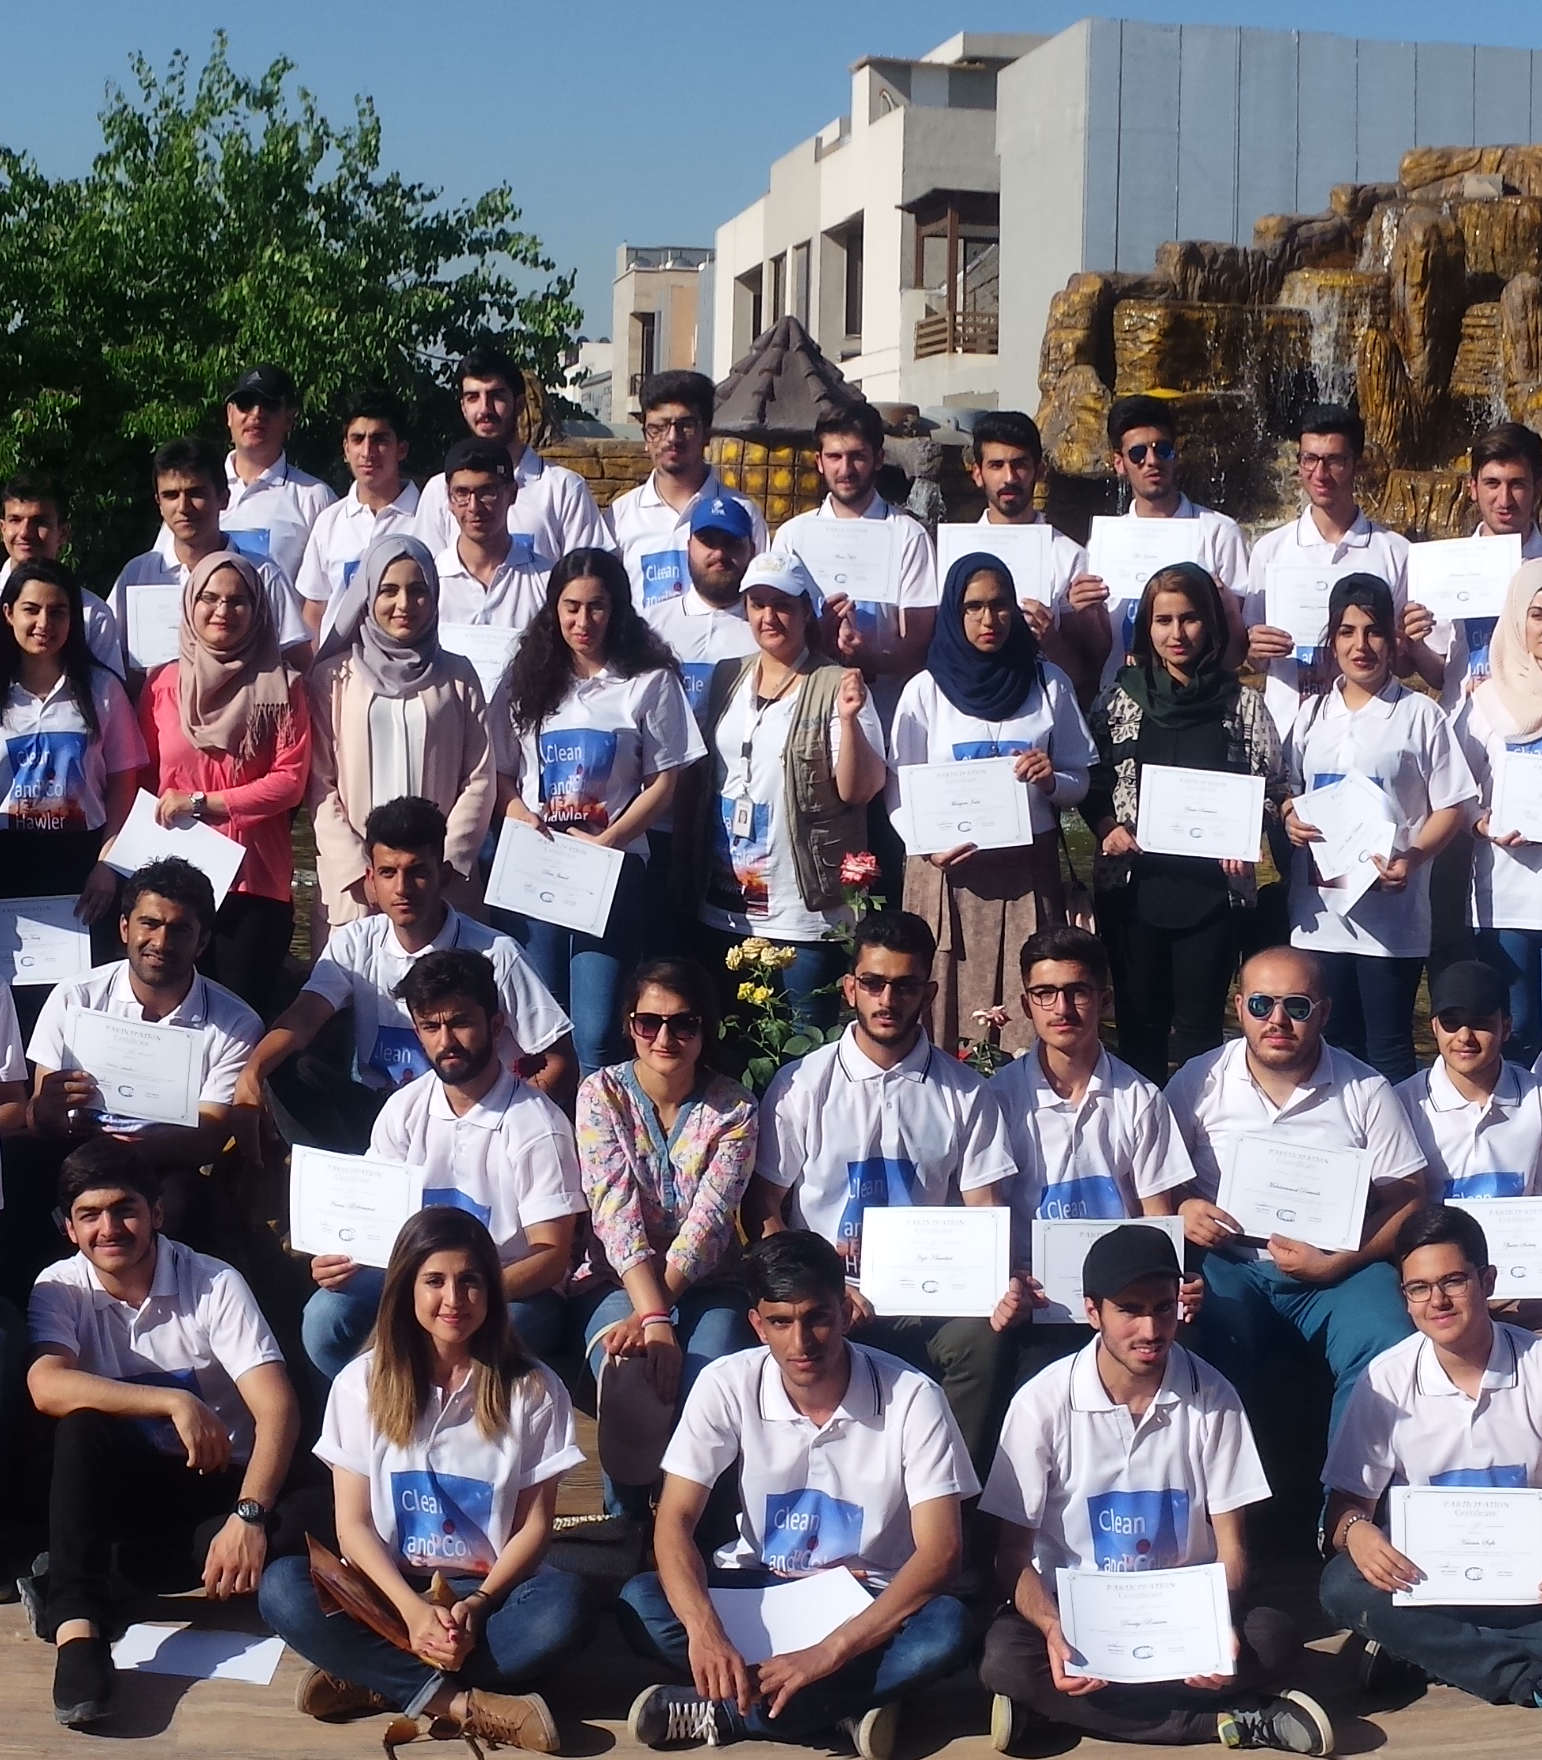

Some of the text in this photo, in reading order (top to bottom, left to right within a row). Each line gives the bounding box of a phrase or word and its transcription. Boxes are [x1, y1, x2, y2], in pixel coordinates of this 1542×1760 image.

[546, 743, 582, 764] Clean
[14, 781, 40, 799] and
[16, 813, 65, 832] Hawler
[1047, 1200, 1087, 1220] Clean
[1444, 1500, 1510, 1509] PARTICIPATION
[1455, 1508, 1497, 1517] Certificate
[773, 1508, 820, 1531] Clean
[1099, 1509, 1147, 1535] Clean
[407, 1533, 437, 1558] and
[768, 1550, 797, 1568] and
[1103, 1553, 1129, 1572] and
[1107, 1582, 1175, 1592] PARTICIPATION
[1118, 1591, 1163, 1600] Certificate
